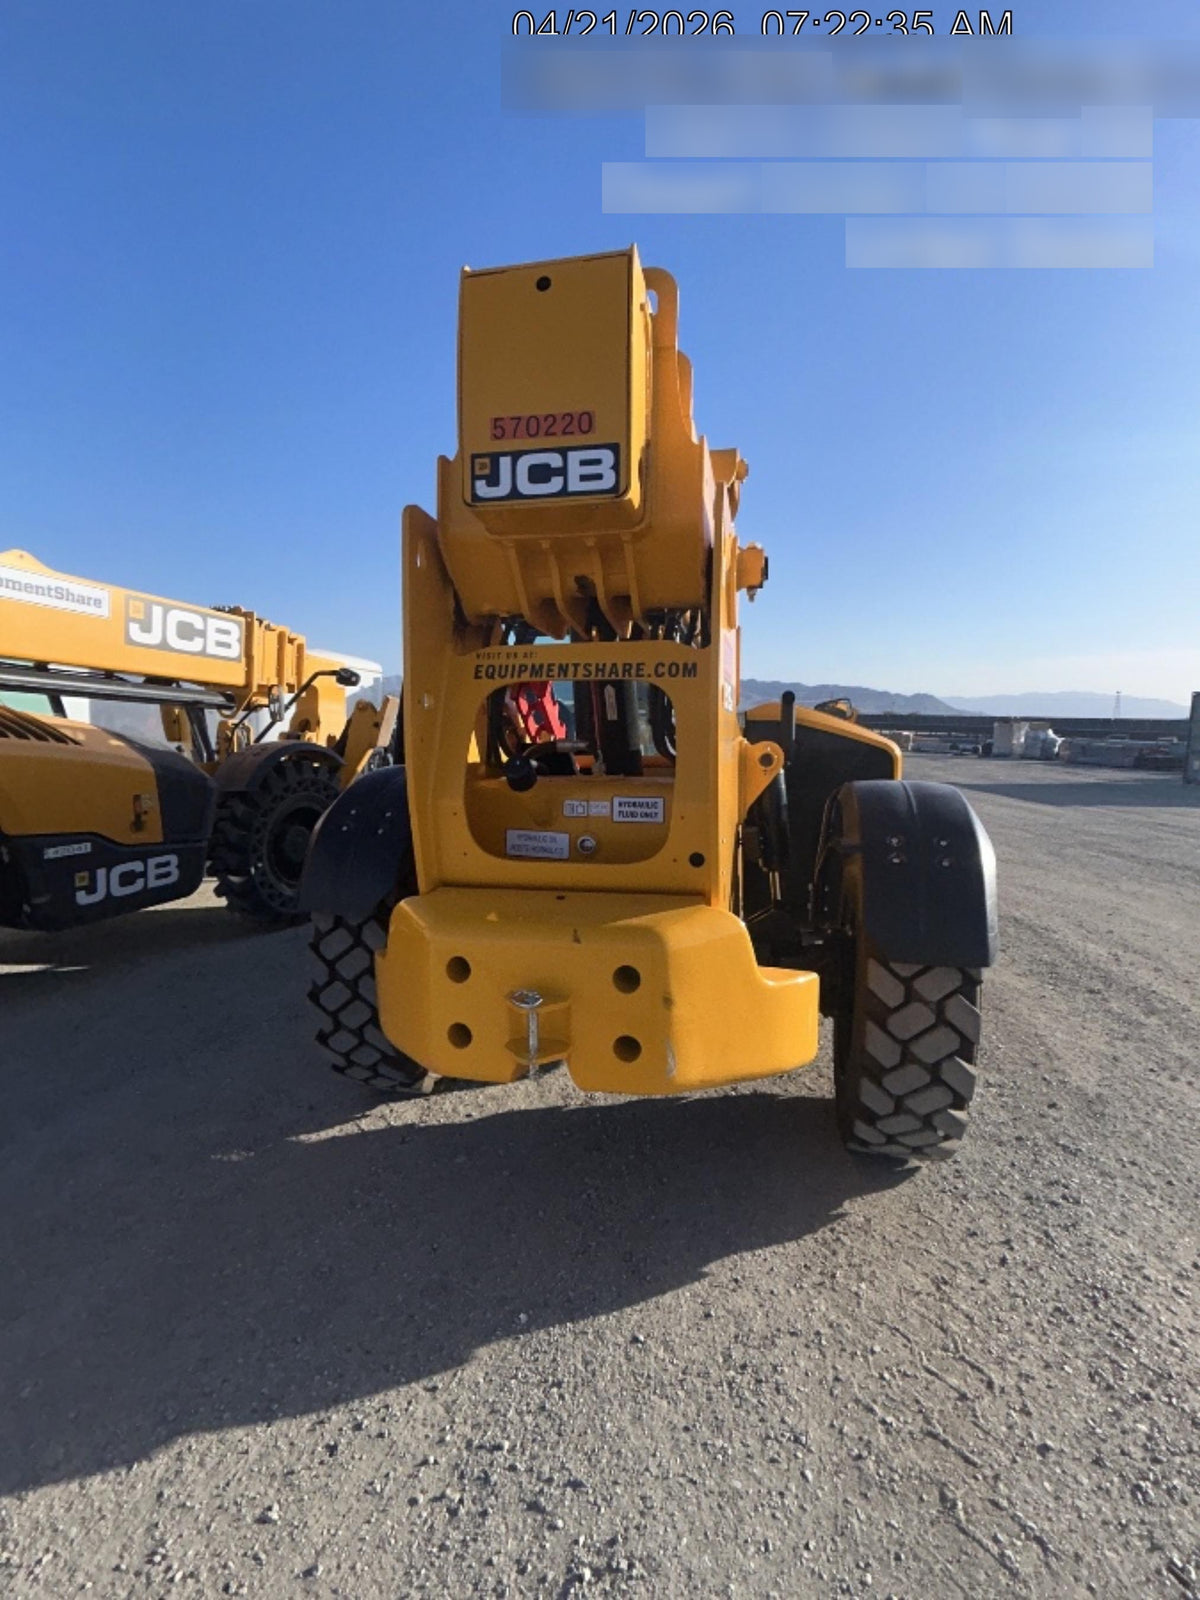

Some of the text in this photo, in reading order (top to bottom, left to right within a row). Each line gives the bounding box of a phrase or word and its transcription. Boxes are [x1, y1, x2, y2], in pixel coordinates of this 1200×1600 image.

[493, 411, 593, 440] 570220
[474, 448, 616, 498] JCB
[128, 605, 241, 659] JCB
[474, 662, 698, 680] EQUIPMENTSHARE.COM
[618, 801, 659, 810] HYDRAULIC
[75, 854, 180, 905] JCB
